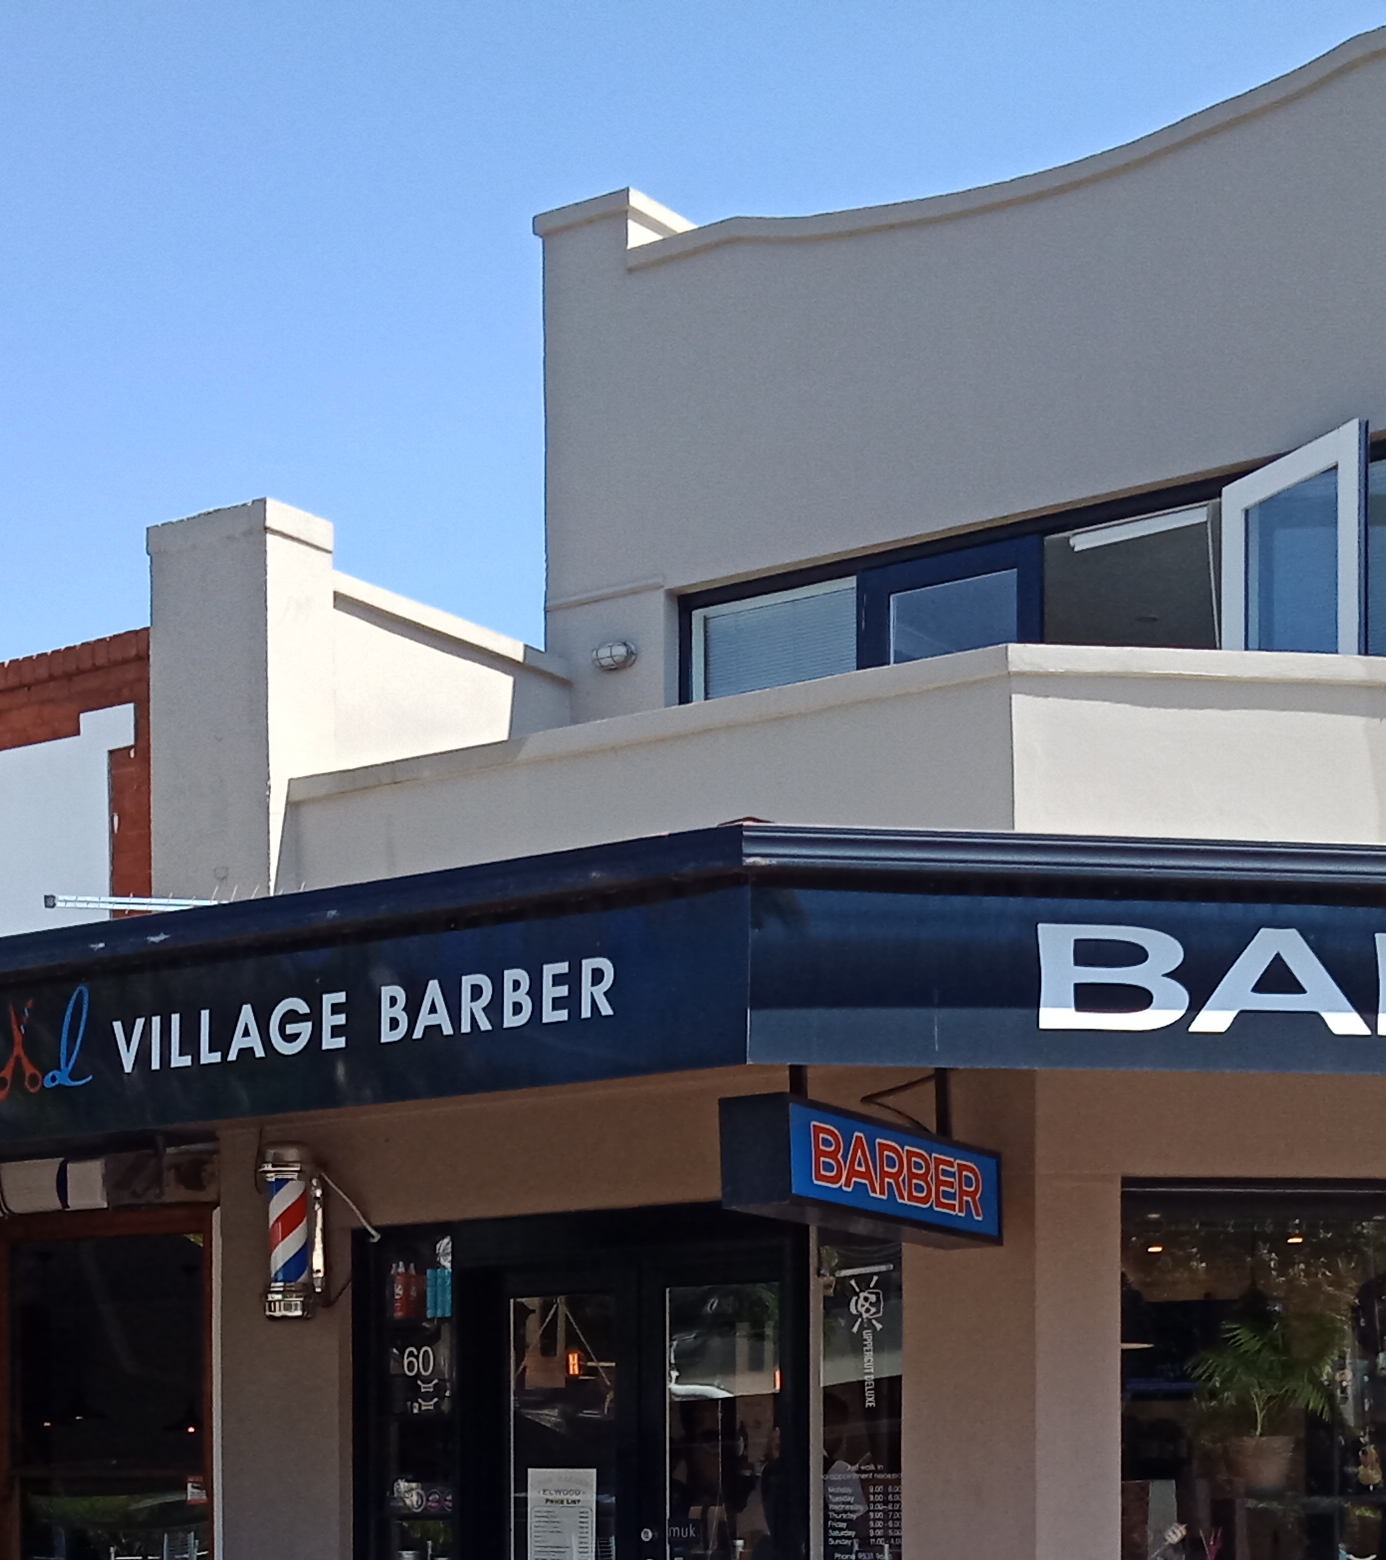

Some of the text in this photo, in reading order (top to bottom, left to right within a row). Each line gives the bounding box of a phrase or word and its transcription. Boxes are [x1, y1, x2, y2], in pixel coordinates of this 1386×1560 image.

[112, 991, 347, 1074] VILLAGE
[380, 957, 615, 1044] BARBER
[810, 1120, 983, 1221] BARBER
[403, 1346, 434, 1377] 60
[862, 1329, 876, 1408] UPPERCUT DELUXE
[542, 1488, 581, 1496] ELWOOD
